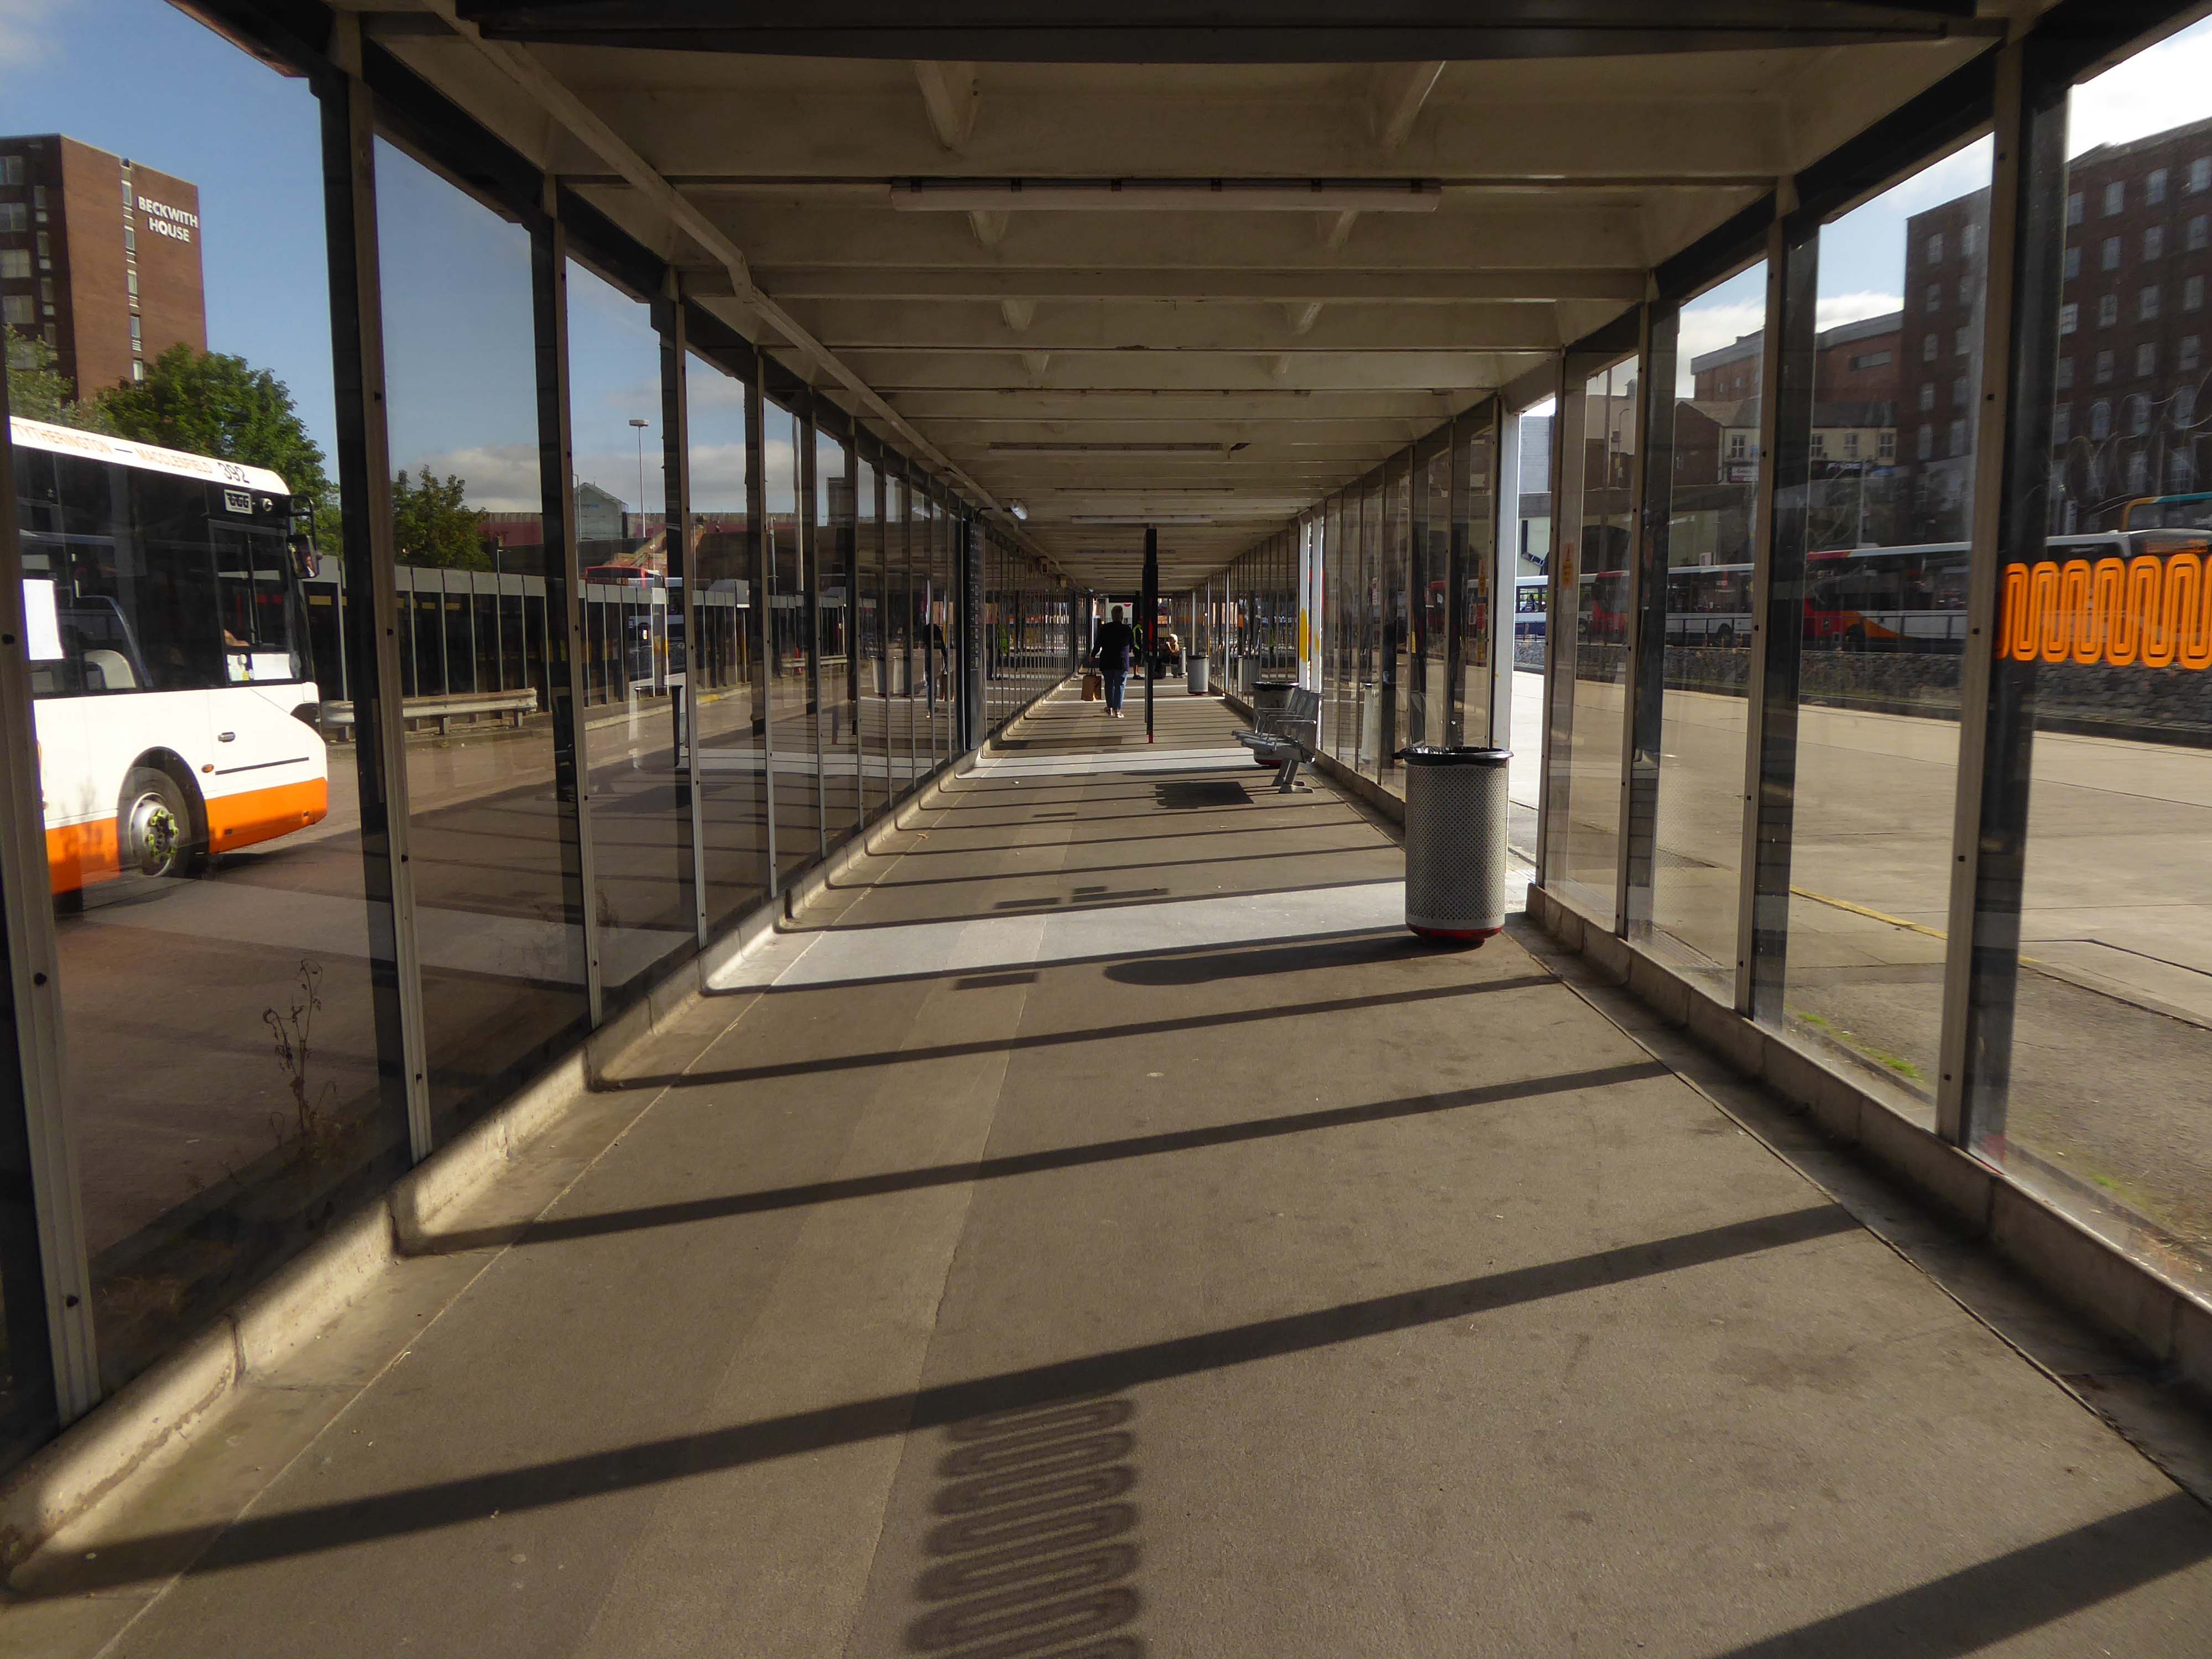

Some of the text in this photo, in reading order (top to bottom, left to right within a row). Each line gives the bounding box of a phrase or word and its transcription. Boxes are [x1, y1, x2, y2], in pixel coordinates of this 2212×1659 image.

[137, 196, 199, 228] BECKWITH
[148, 216, 190, 243] HOUSE
[217, 462, 251, 484] 392
